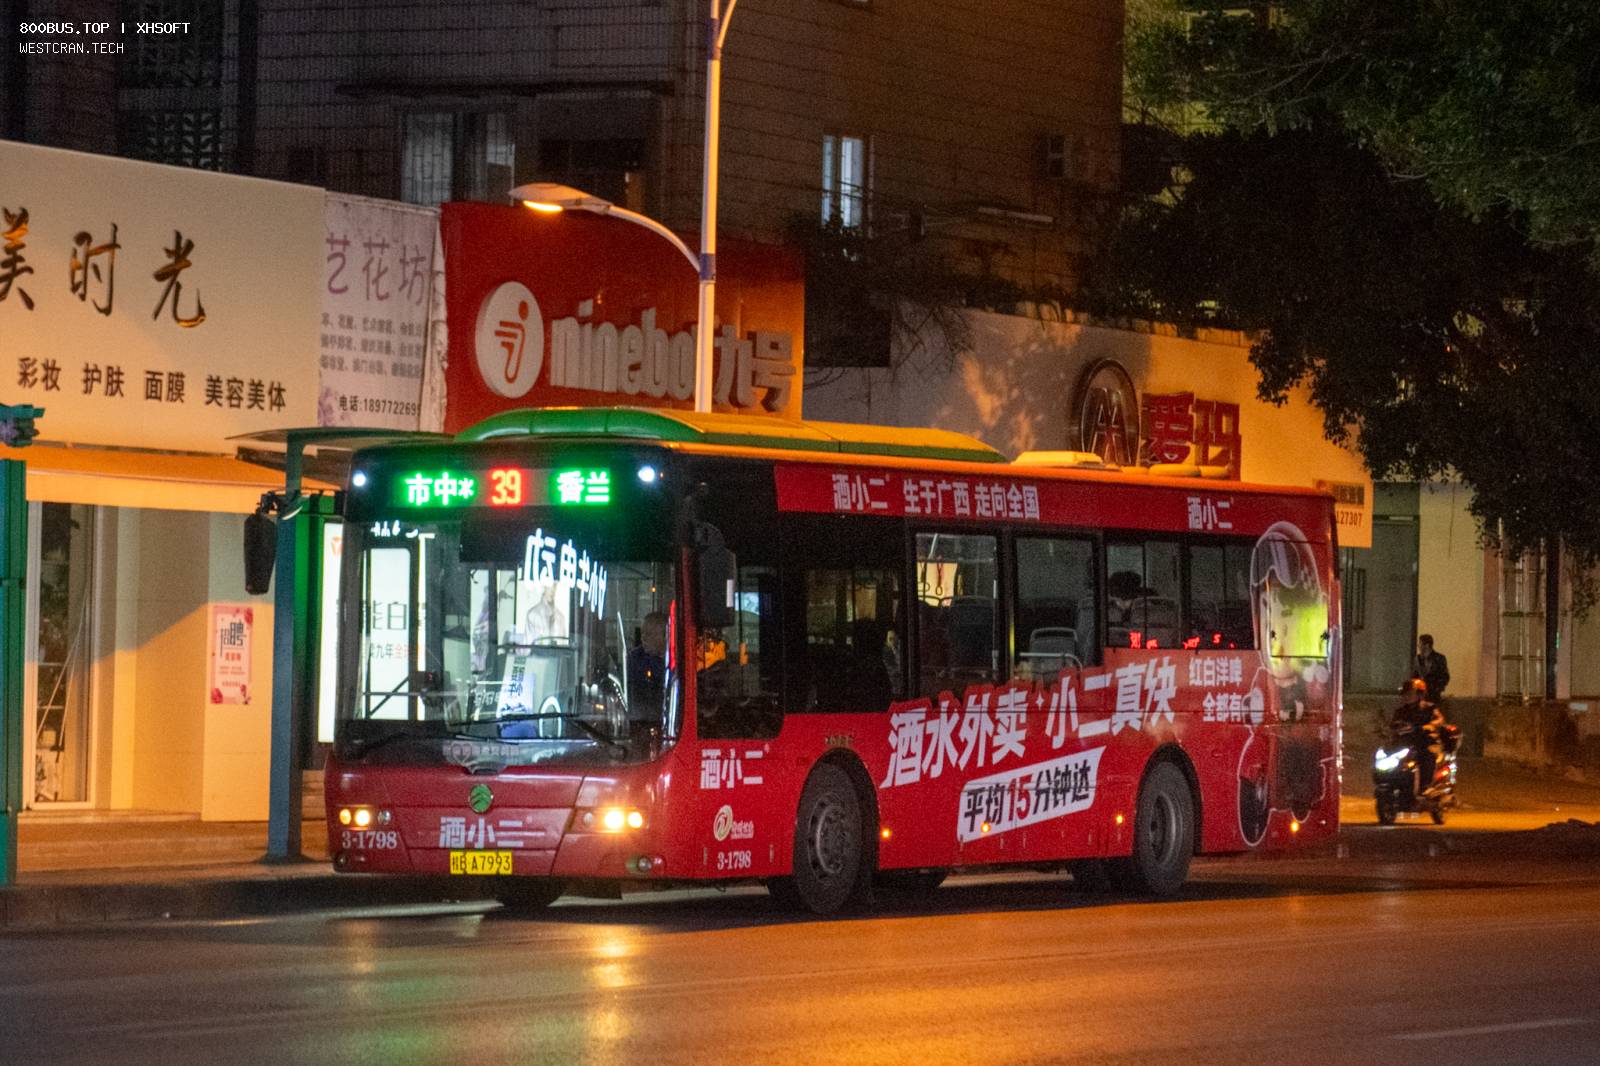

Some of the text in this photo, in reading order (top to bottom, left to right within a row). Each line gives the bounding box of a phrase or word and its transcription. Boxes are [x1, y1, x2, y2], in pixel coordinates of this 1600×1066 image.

[326, 232, 427, 306] 艺花坊
[18, 357, 287, 412] 彩妆 护肤 面膜 美容美体
[715, 324, 797, 412] 九号
[491, 469, 522, 504] 39
[557, 470, 610, 503] 香兰
[831, 473, 1040, 520] 酒小二 生于广西 走向全国
[1187, 495, 1233, 530] 酒小二
[879, 655, 1177, 789] 酒水外卖 小二真快
[700, 748, 764, 789] 酒小二
[963, 759, 1092, 833] 平均15分钟达
[341, 831, 398, 849] 3-1798
[717, 850, 751, 870] 3-1798
